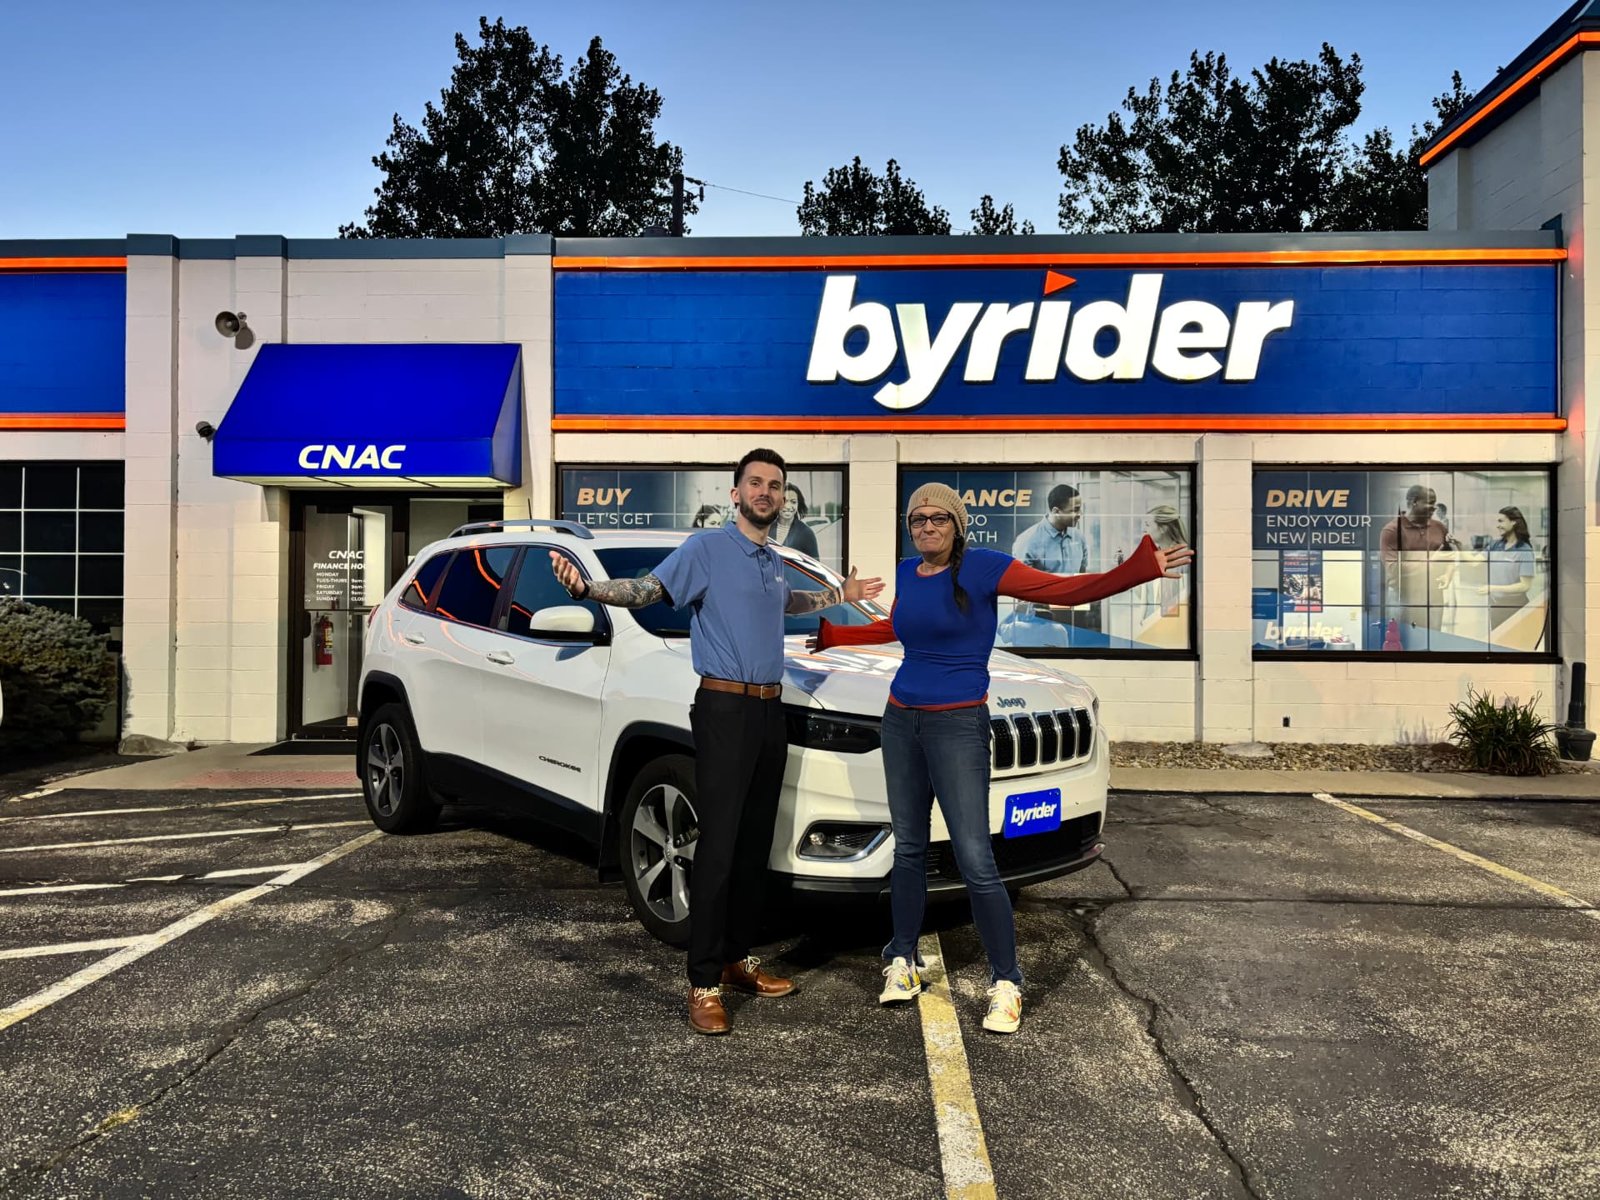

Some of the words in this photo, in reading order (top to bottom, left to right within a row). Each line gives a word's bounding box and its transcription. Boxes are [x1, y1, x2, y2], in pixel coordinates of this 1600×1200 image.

[806, 268, 1294, 409] byrider
[298, 444, 406, 469] CNAC
[576, 488, 632, 506] BUY
[957, 489, 1033, 507] ANCE
[1265, 489, 1350, 508] DRIVE
[577, 512, 618, 525] LET'S
[622, 512, 654, 525] GET
[1266, 515, 1320, 528] ENJOY
[1324, 515, 1372, 528] YOUR
[965, 531, 998, 543] ATH
[1266, 532, 1306, 544] NEW
[1311, 532, 1355, 544] RIDE!
[328, 550, 364, 559] CNAC
[313, 562, 349, 570] FINANCE
[1264, 621, 1344, 644] byrider
[539, 755, 581, 773] CHEROKEE
[1010, 802, 1057, 827] byrider
